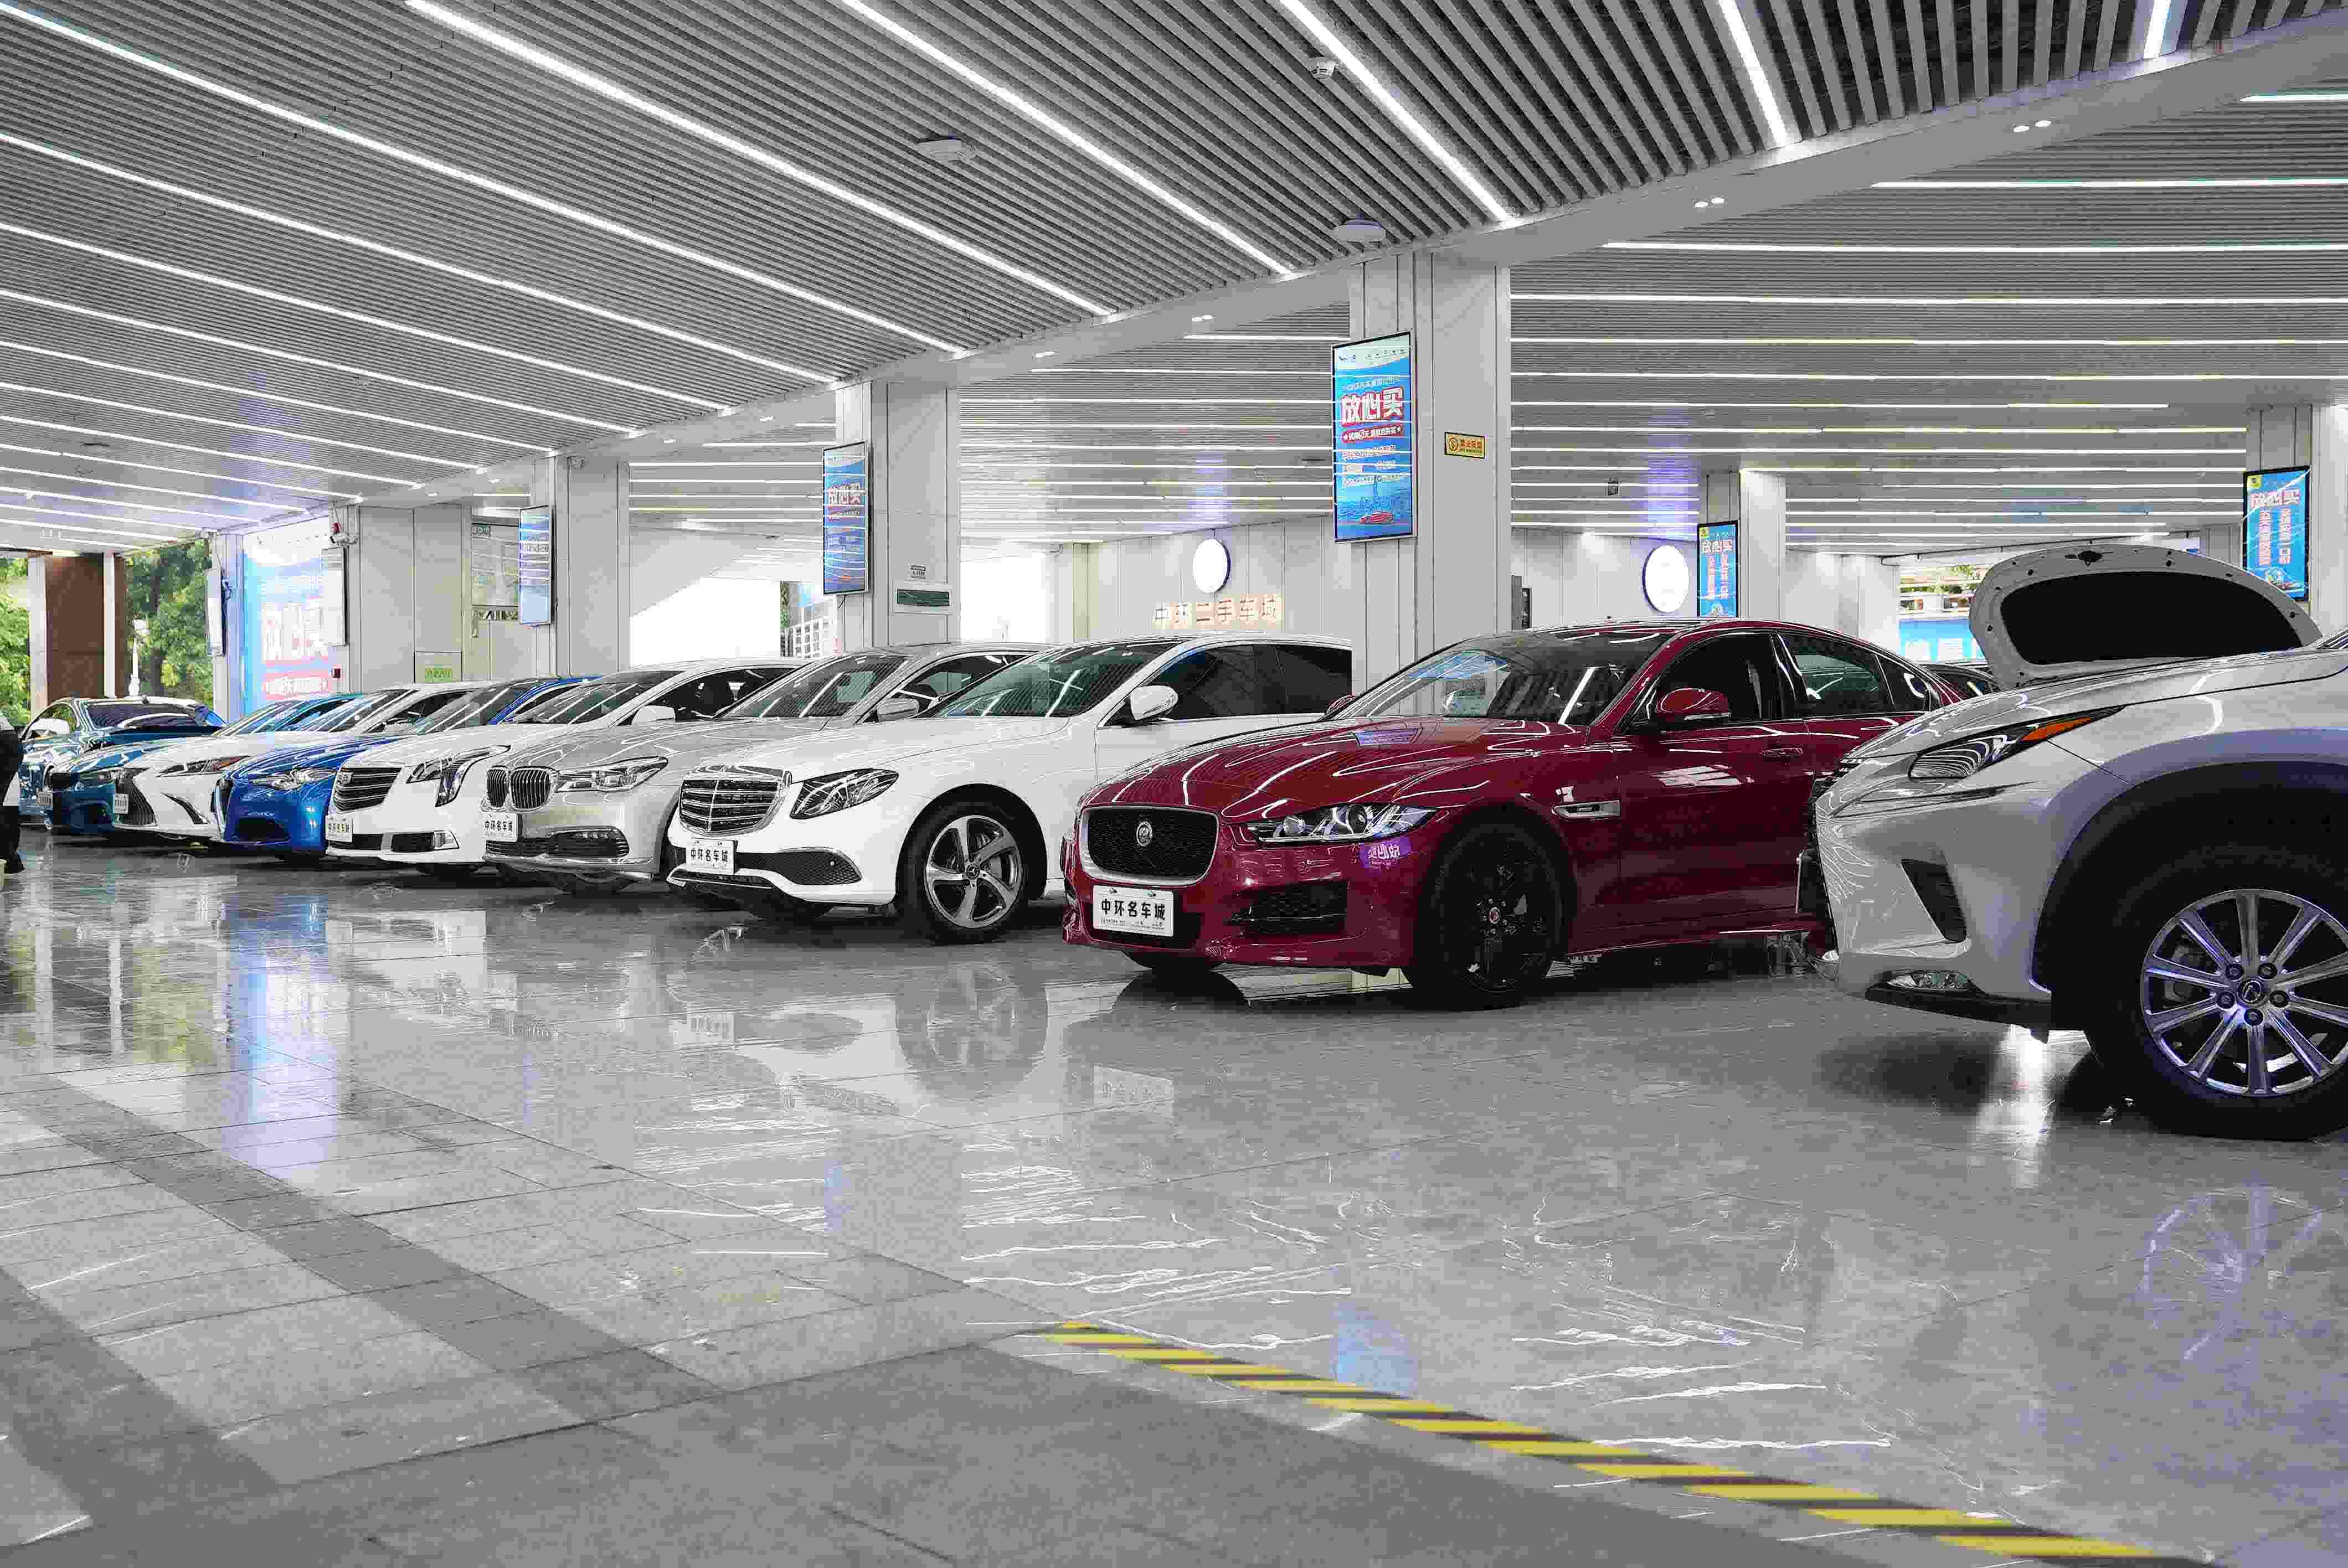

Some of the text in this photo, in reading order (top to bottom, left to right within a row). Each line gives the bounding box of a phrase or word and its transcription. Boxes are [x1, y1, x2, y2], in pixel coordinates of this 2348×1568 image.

[1341, 387, 1403, 425] 放心买
[1101, 899, 1166, 920] 中环名车城
